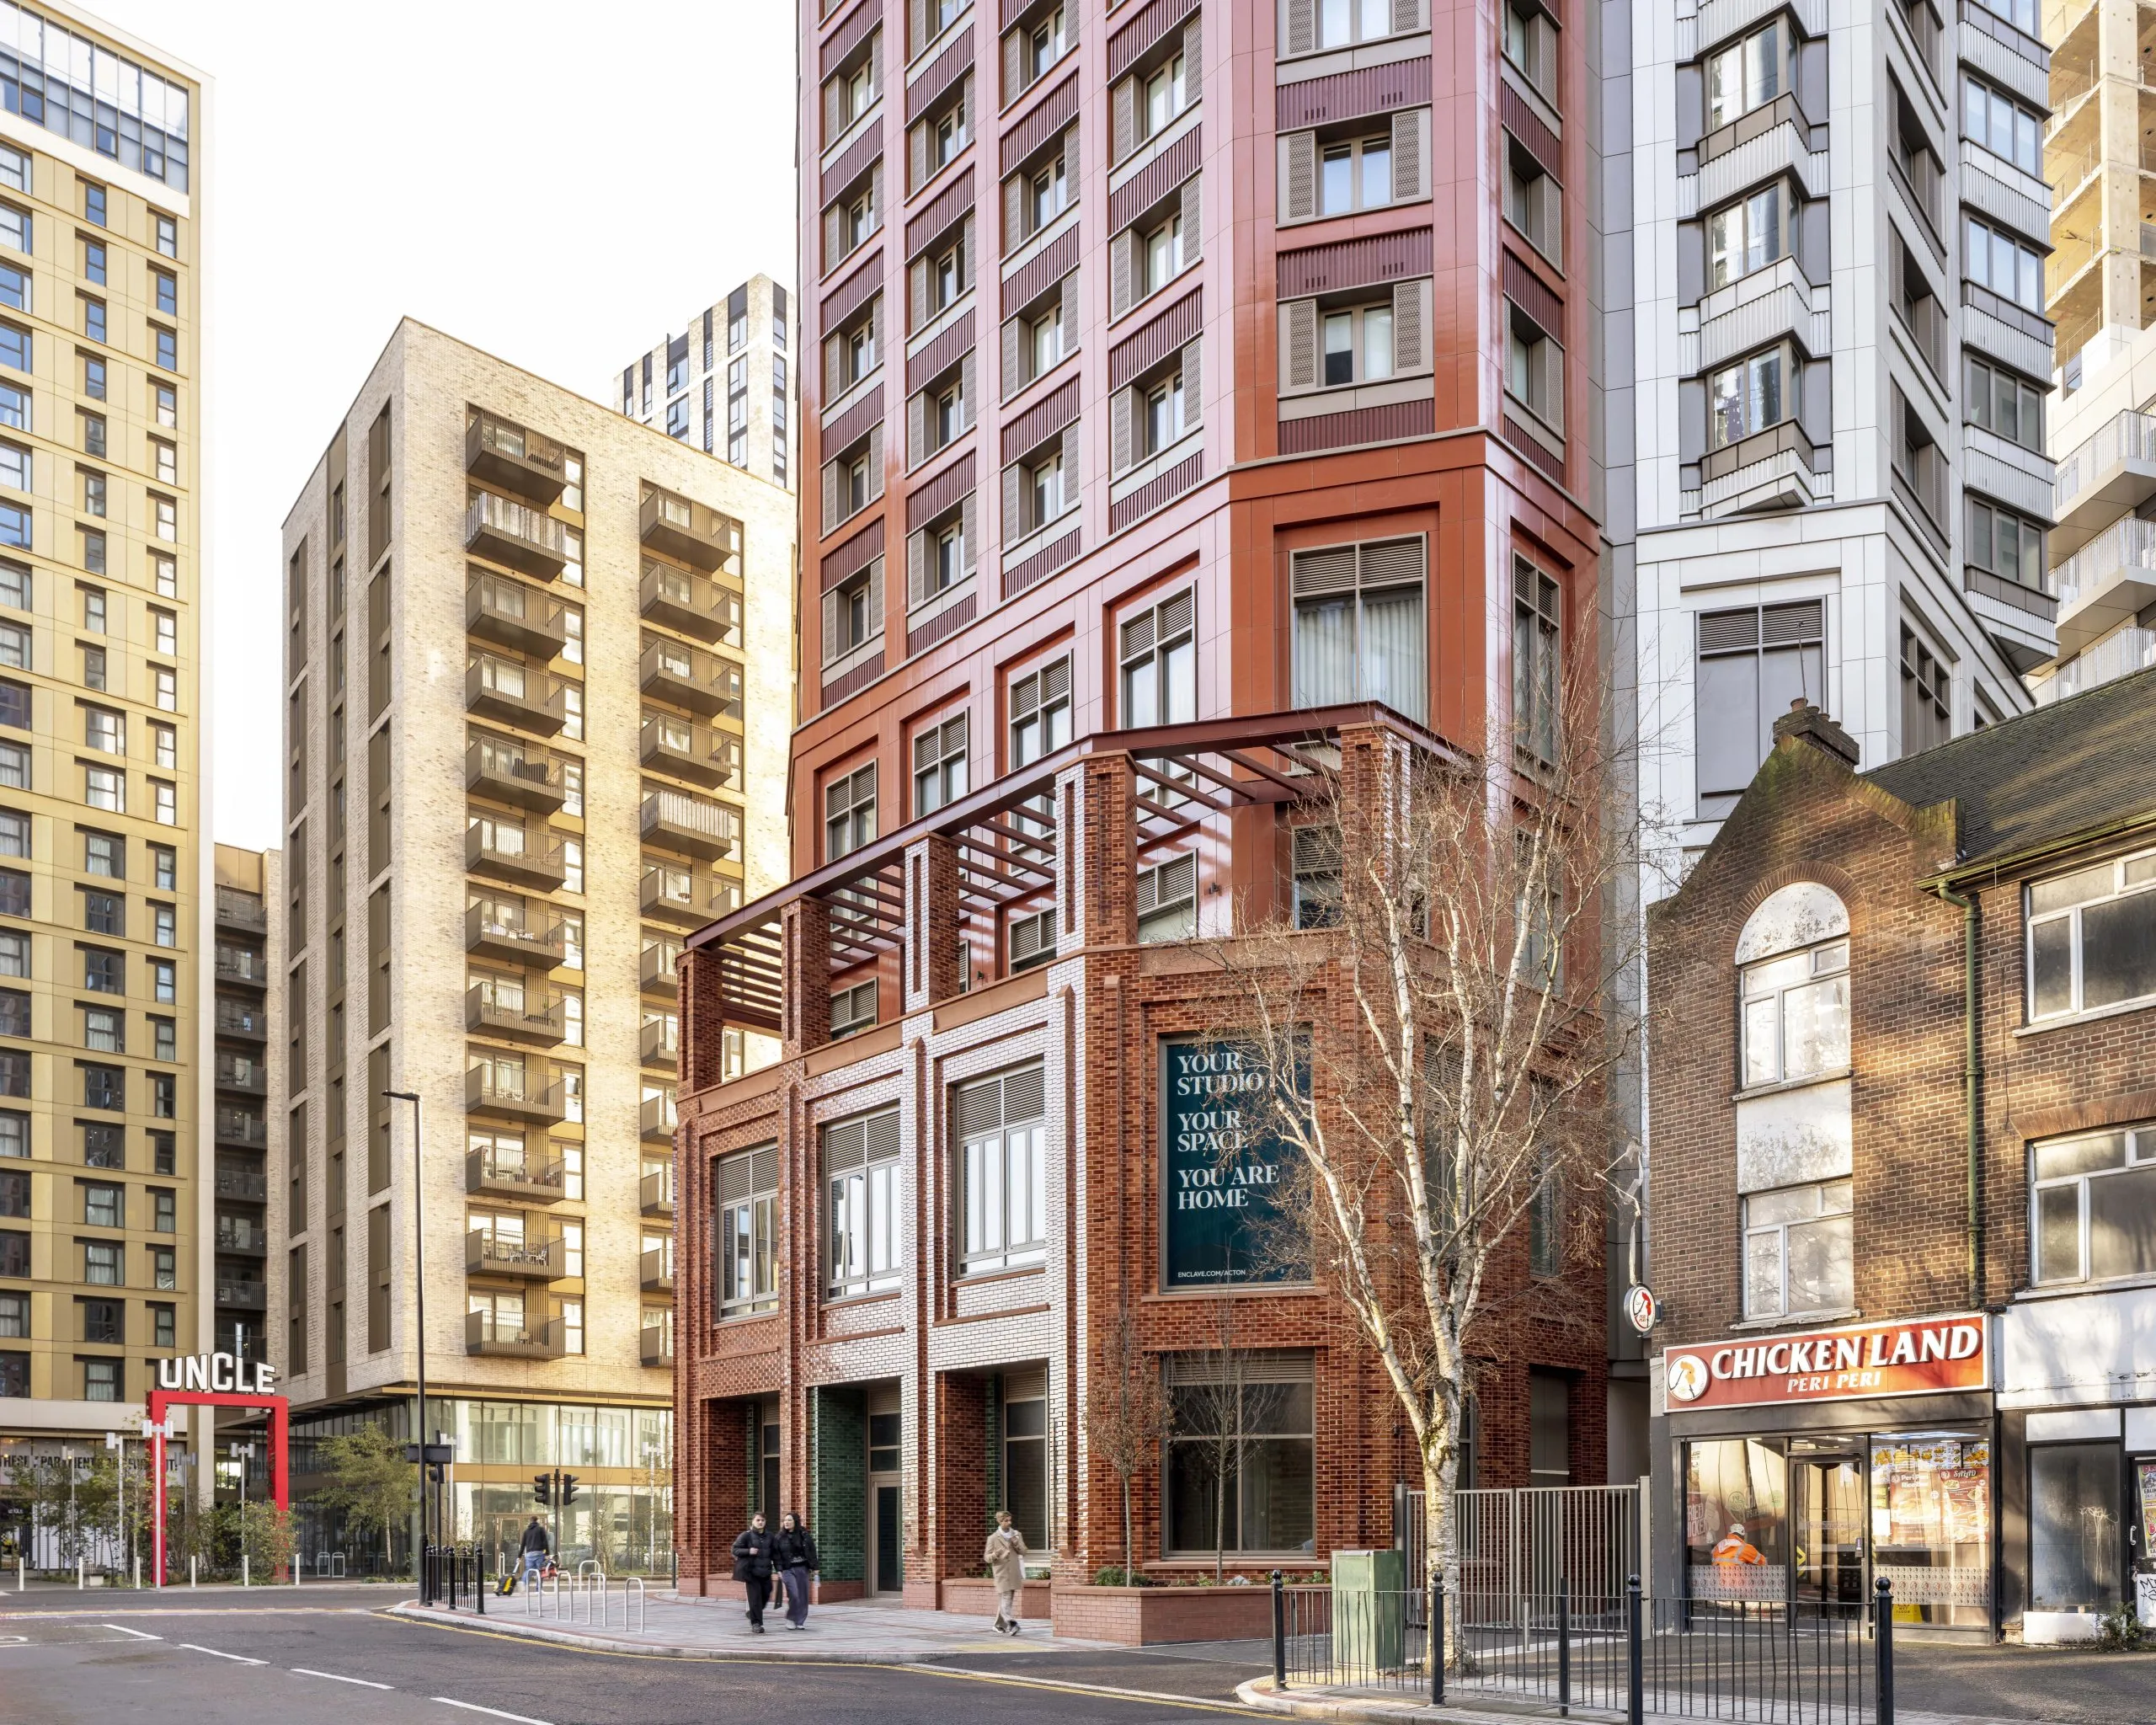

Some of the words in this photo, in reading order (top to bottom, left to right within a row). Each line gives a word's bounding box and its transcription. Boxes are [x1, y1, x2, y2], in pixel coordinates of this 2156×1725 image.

[1177, 1053, 1241, 1074] YOUR
[1177, 1072, 1263, 1096] STUDIO
[1177, 1110, 1242, 1131] YOUR
[1177, 1130, 1248, 1152] SPACE
[1177, 1168, 1226, 1188] YOU
[1230, 1165, 1279, 1185] ARE
[1177, 1188, 1249, 1210] HOME
[1177, 1269, 1246, 1278] ENCLAVE.COM/ACTON
[1710, 1334, 1865, 1381] CHICKEN
[1869, 1325, 1983, 1367] LAND
[160, 1352, 275, 1393] UNCLE
[1786, 1375, 1829, 1393] PERI
[1836, 1370, 1881, 1390] PERI
